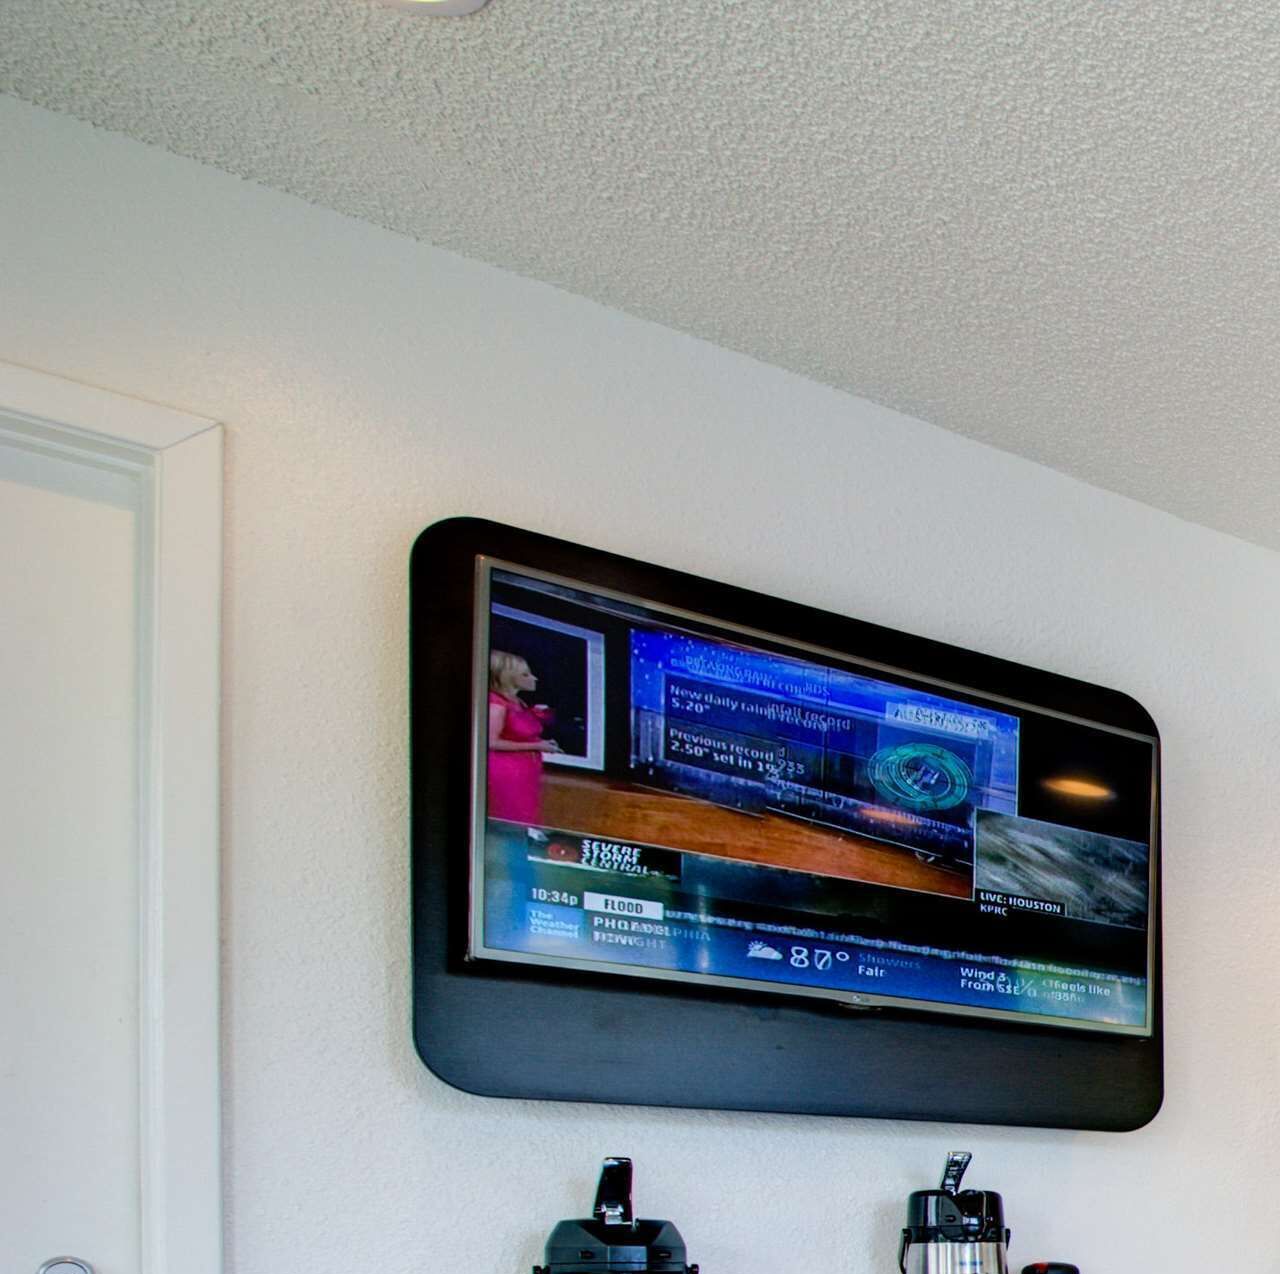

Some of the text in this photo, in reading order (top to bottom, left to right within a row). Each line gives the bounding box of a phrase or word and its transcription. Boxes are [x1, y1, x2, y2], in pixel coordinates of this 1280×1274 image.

[670, 728, 774, 762] Previous record
[712, 751, 735, 766] set
[582, 839, 643, 857] SEVERE
[581, 850, 638, 864] STORM
[581, 857, 650, 875] CENTRAL
[531, 887, 579, 906] 10:34p
[980, 891, 1061, 914] LIVE: HOUSTON
[604, 898, 644, 915] FLOOD
[857, 964, 885, 979] Fair
[960, 967, 995, 982] Wind
[960, 979, 995, 993] From
[1088, 984, 1111, 997] like
